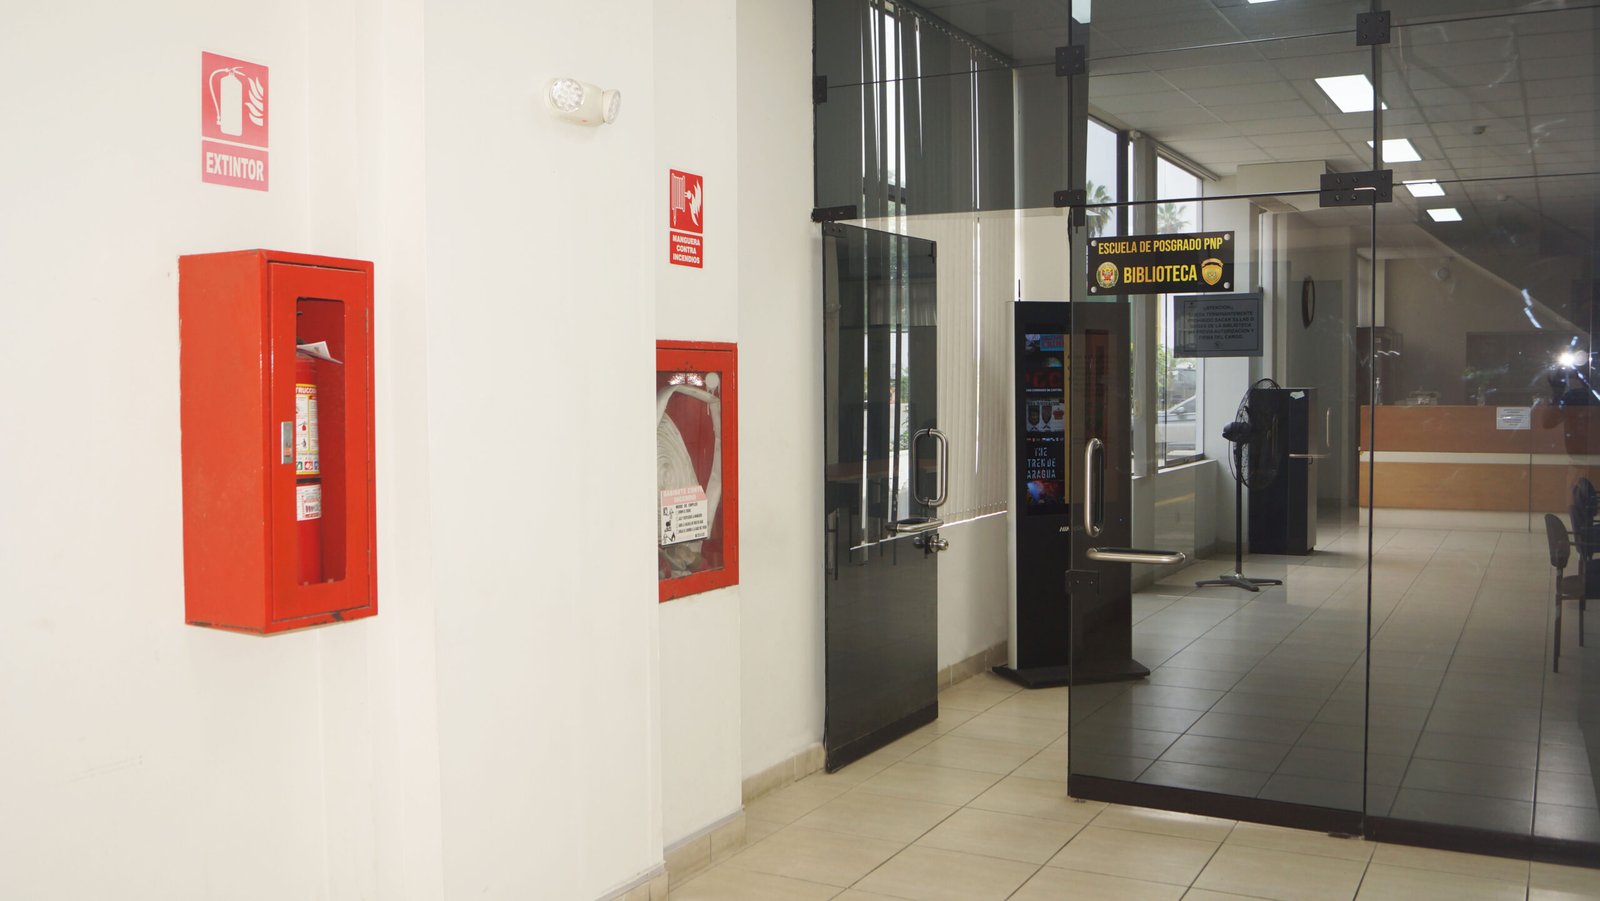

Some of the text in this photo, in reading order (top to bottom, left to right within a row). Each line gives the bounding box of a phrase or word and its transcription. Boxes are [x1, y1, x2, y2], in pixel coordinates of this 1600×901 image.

[206, 151, 265, 182] EXTINTOR
[672, 234, 700, 246] MANGUERA
[1098, 237, 1223, 255] ESCUELA DE POSGRADO PNP
[676, 244, 697, 255] CONTRA
[672, 253, 700, 264] INCENDIOS
[1123, 264, 1198, 284] BIBLIOTECA
[1026, 469, 1056, 480] ARAGUA
